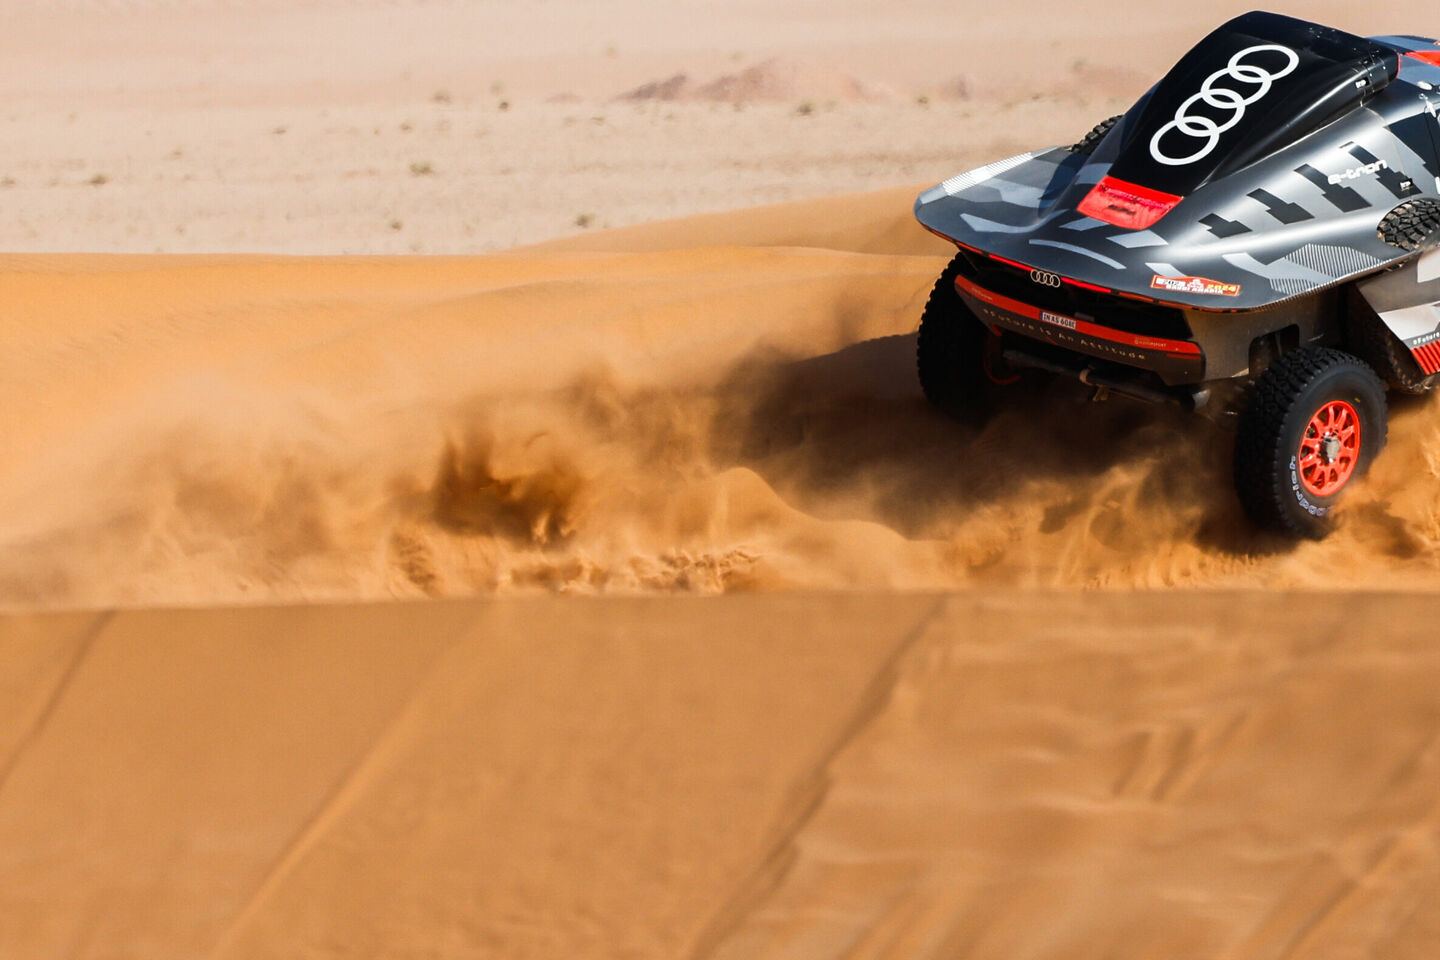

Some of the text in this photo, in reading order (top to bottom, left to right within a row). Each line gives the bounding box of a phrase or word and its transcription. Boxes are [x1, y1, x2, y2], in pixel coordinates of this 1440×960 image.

[1327, 159, 1388, 185] e-tron
[1165, 284, 1224, 295] SAUDI ARABIA
